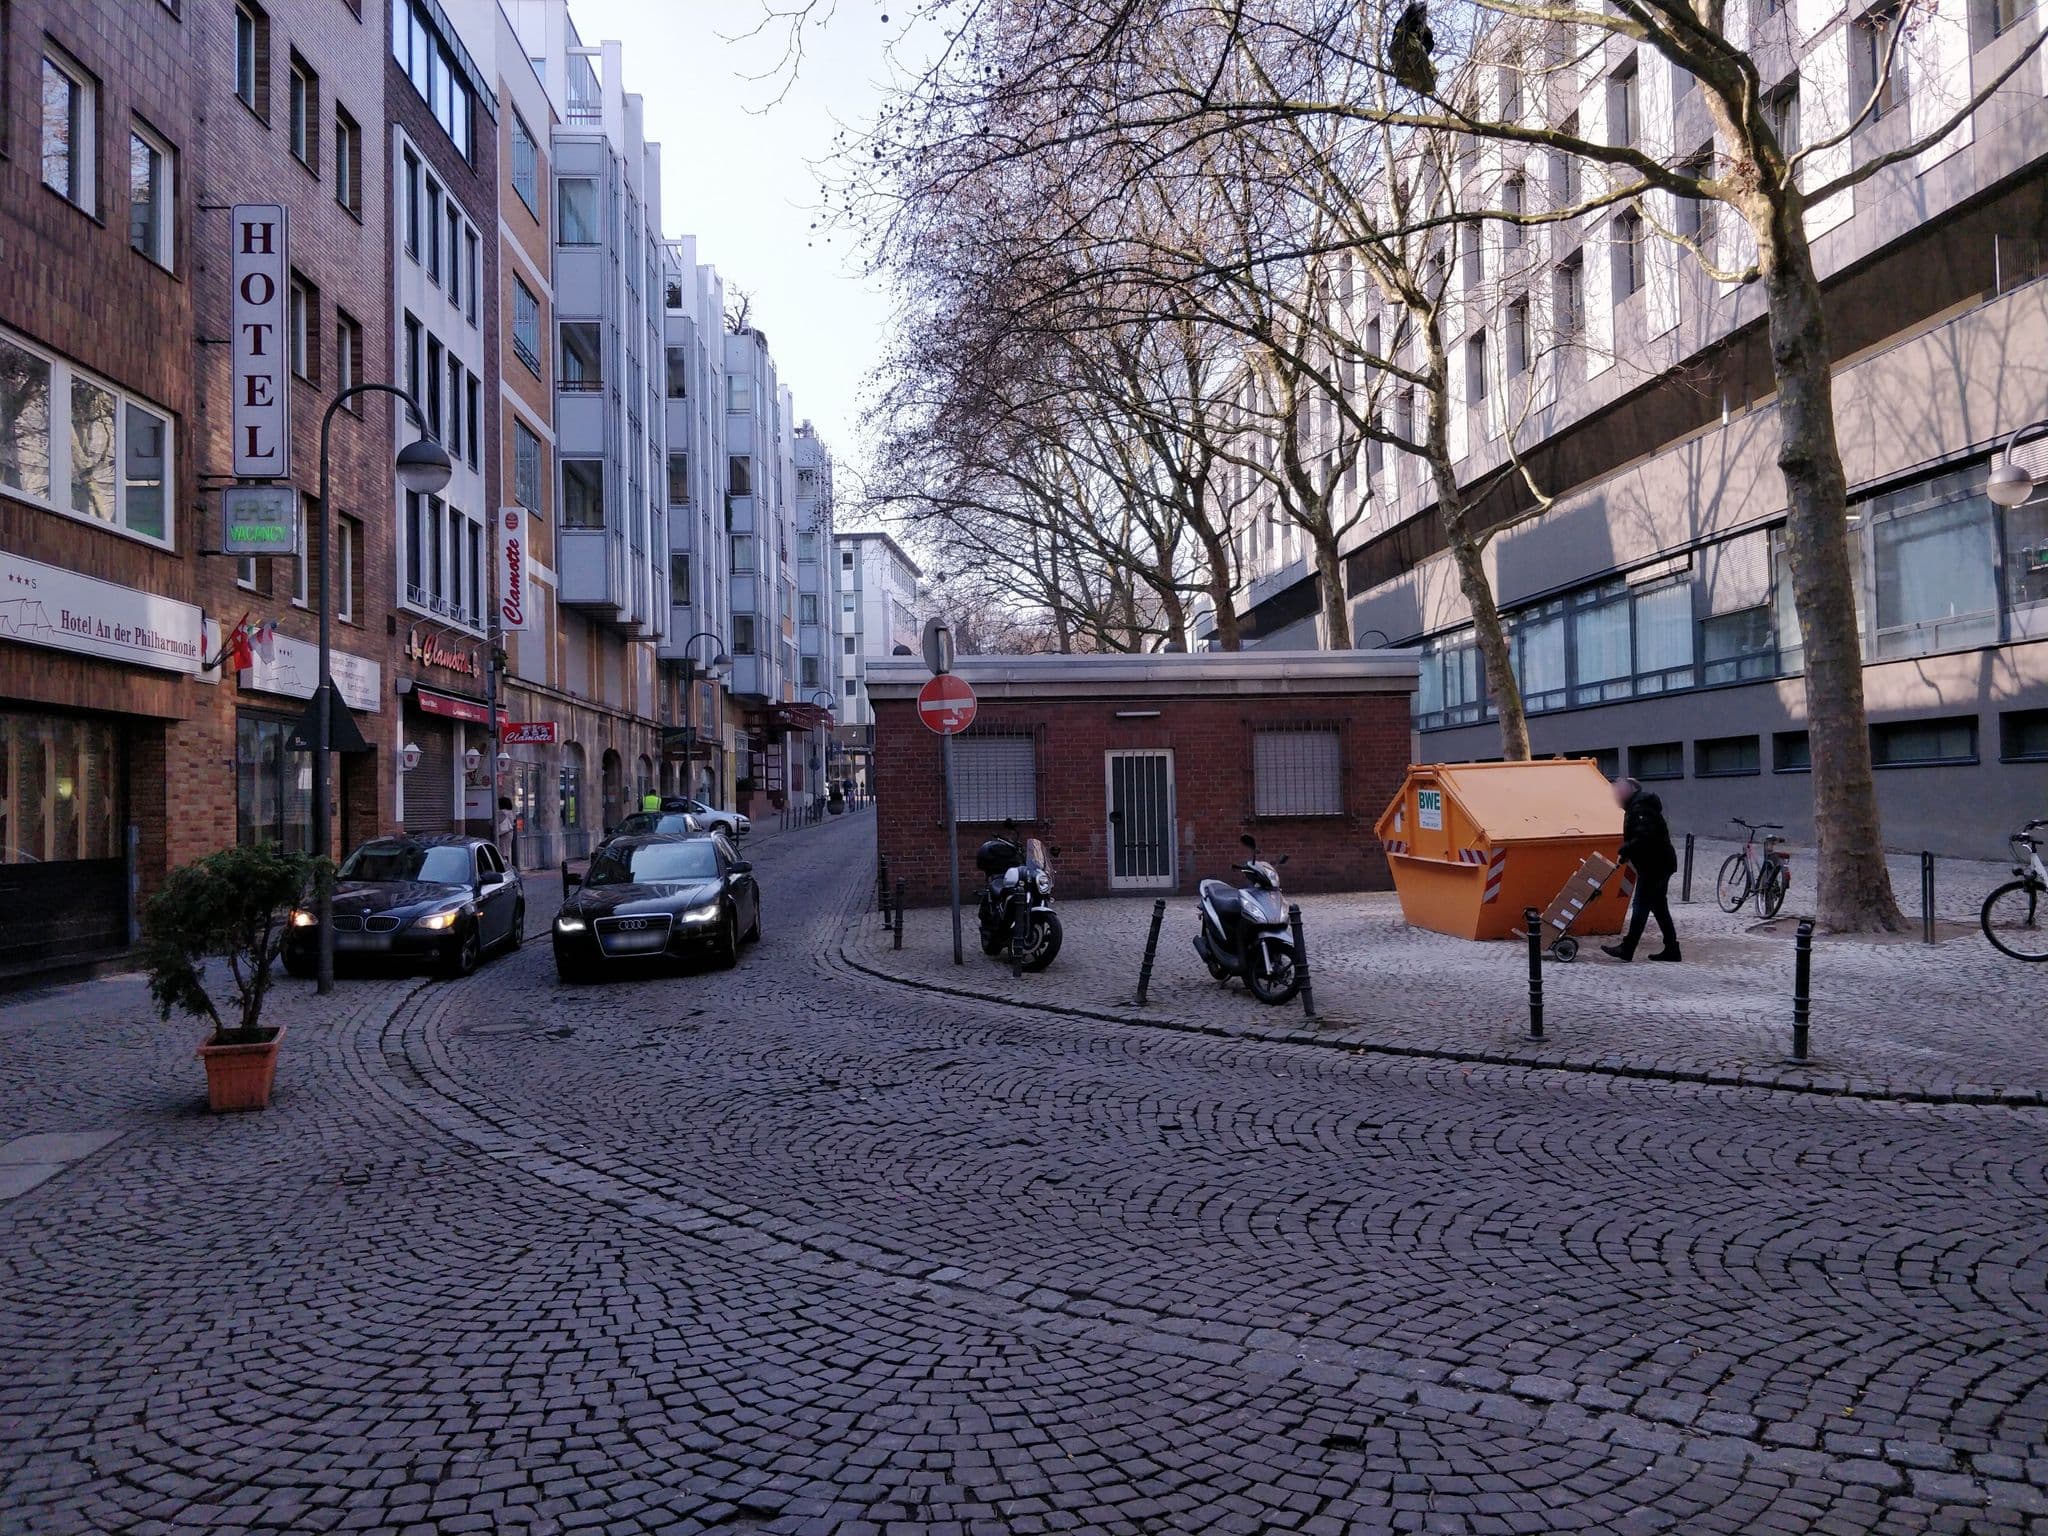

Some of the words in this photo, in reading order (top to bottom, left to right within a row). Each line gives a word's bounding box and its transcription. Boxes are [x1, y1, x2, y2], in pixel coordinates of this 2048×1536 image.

[240, 222, 275, 458] HOTEL
[230, 523, 286, 542] VACANCY
[502, 537, 522, 625] Clamotte
[61, 609, 92, 635] Hotel
[95, 621, 111, 639] An
[114, 623, 132, 643] der
[135, 627, 197, 657] Philharmonie
[423, 634, 469, 672] Clamotte
[1418, 791, 1441, 811] BWE
